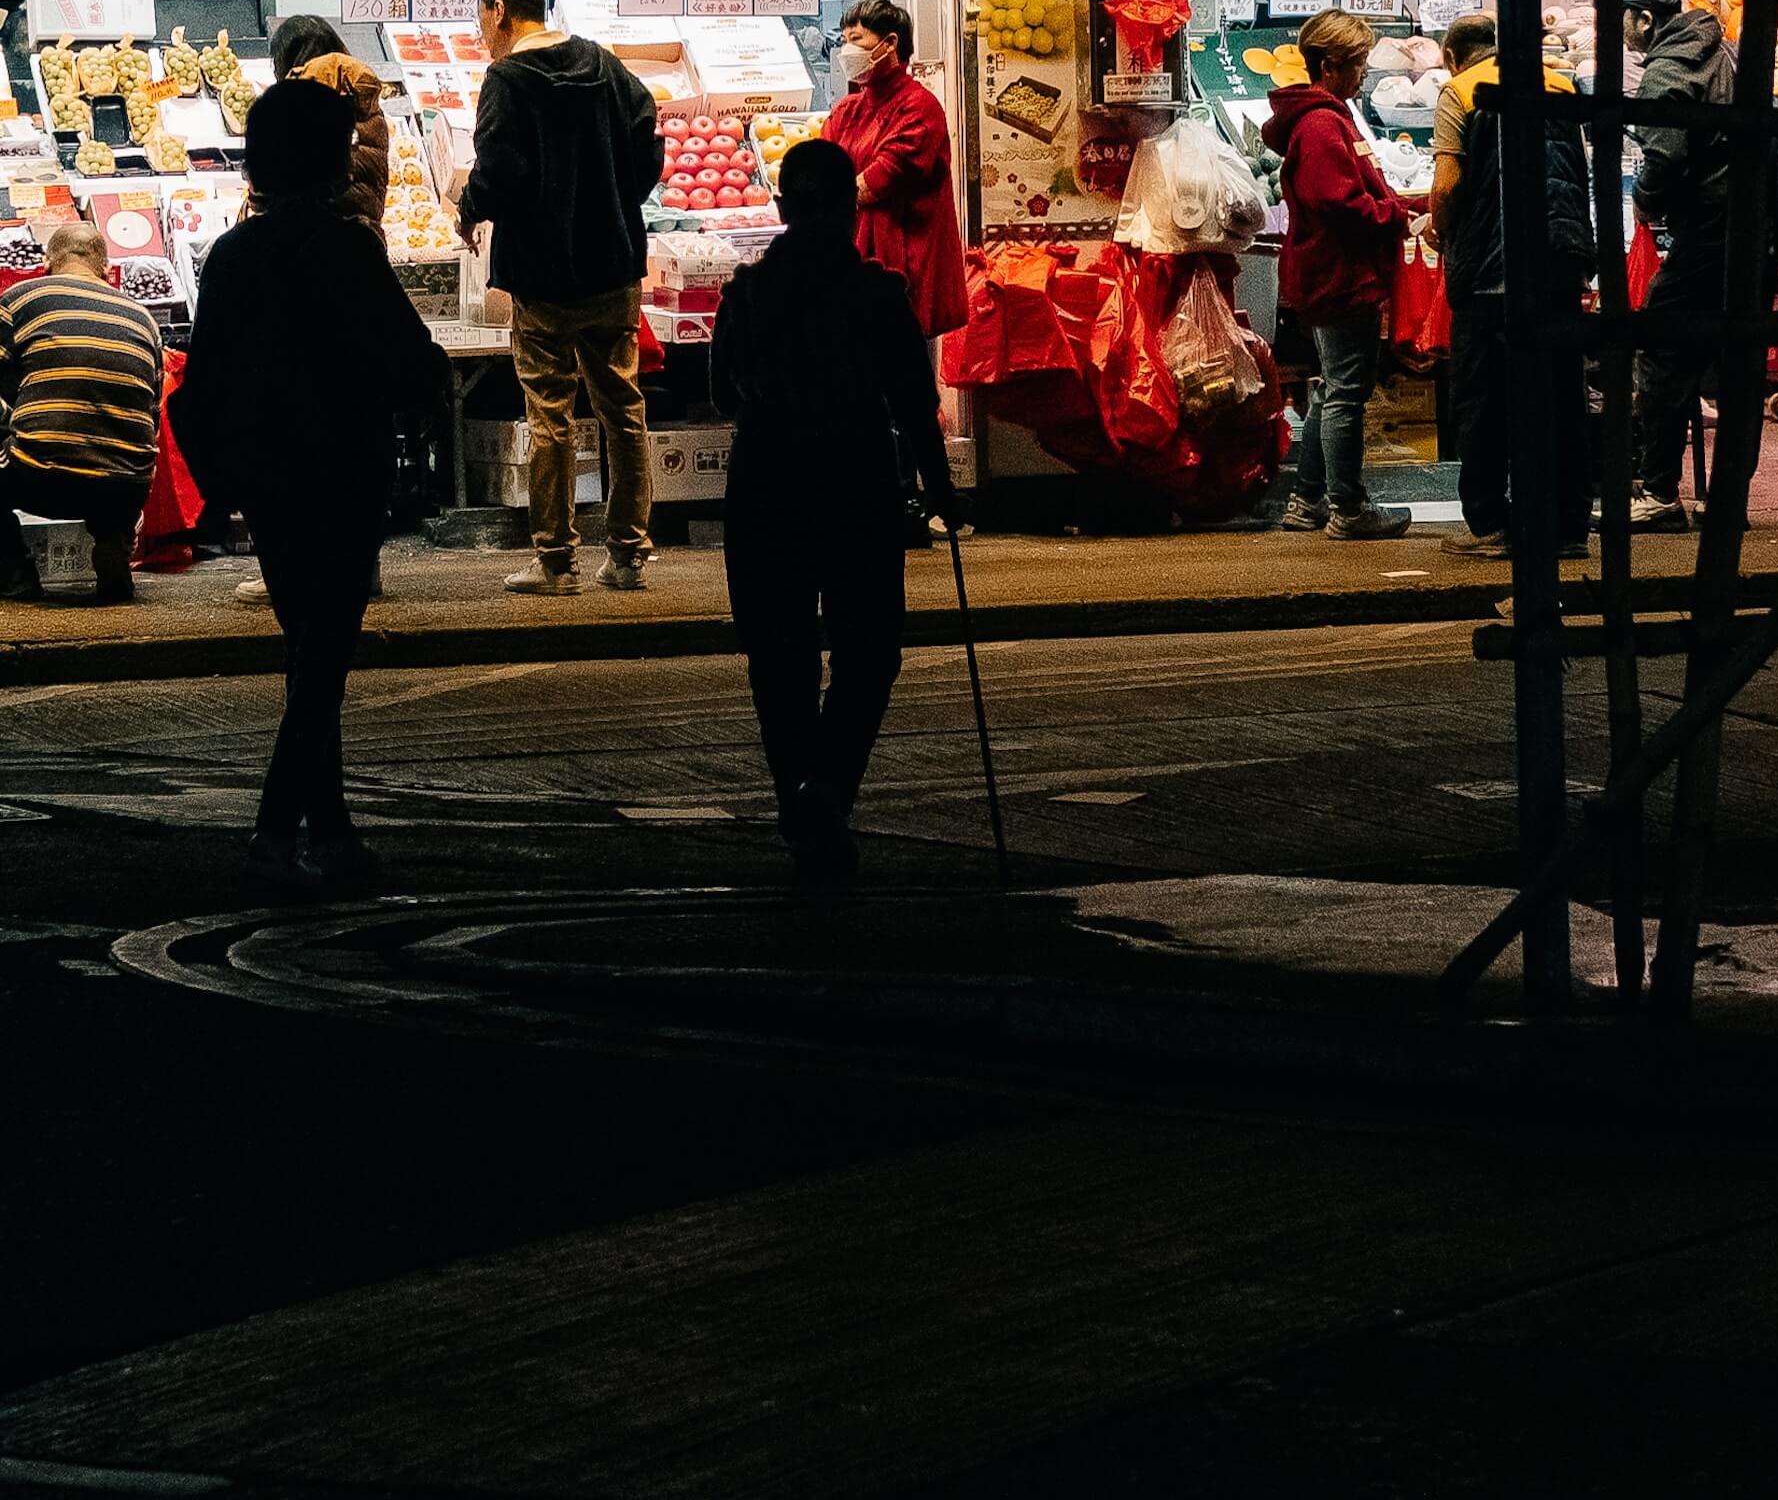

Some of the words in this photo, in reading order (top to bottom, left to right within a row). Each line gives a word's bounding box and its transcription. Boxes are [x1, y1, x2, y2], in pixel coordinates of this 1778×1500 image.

[660, 112, 687, 120] GOLD
[717, 104, 769, 118] HAWAIIAN
[770, 103, 798, 113] GOLD
